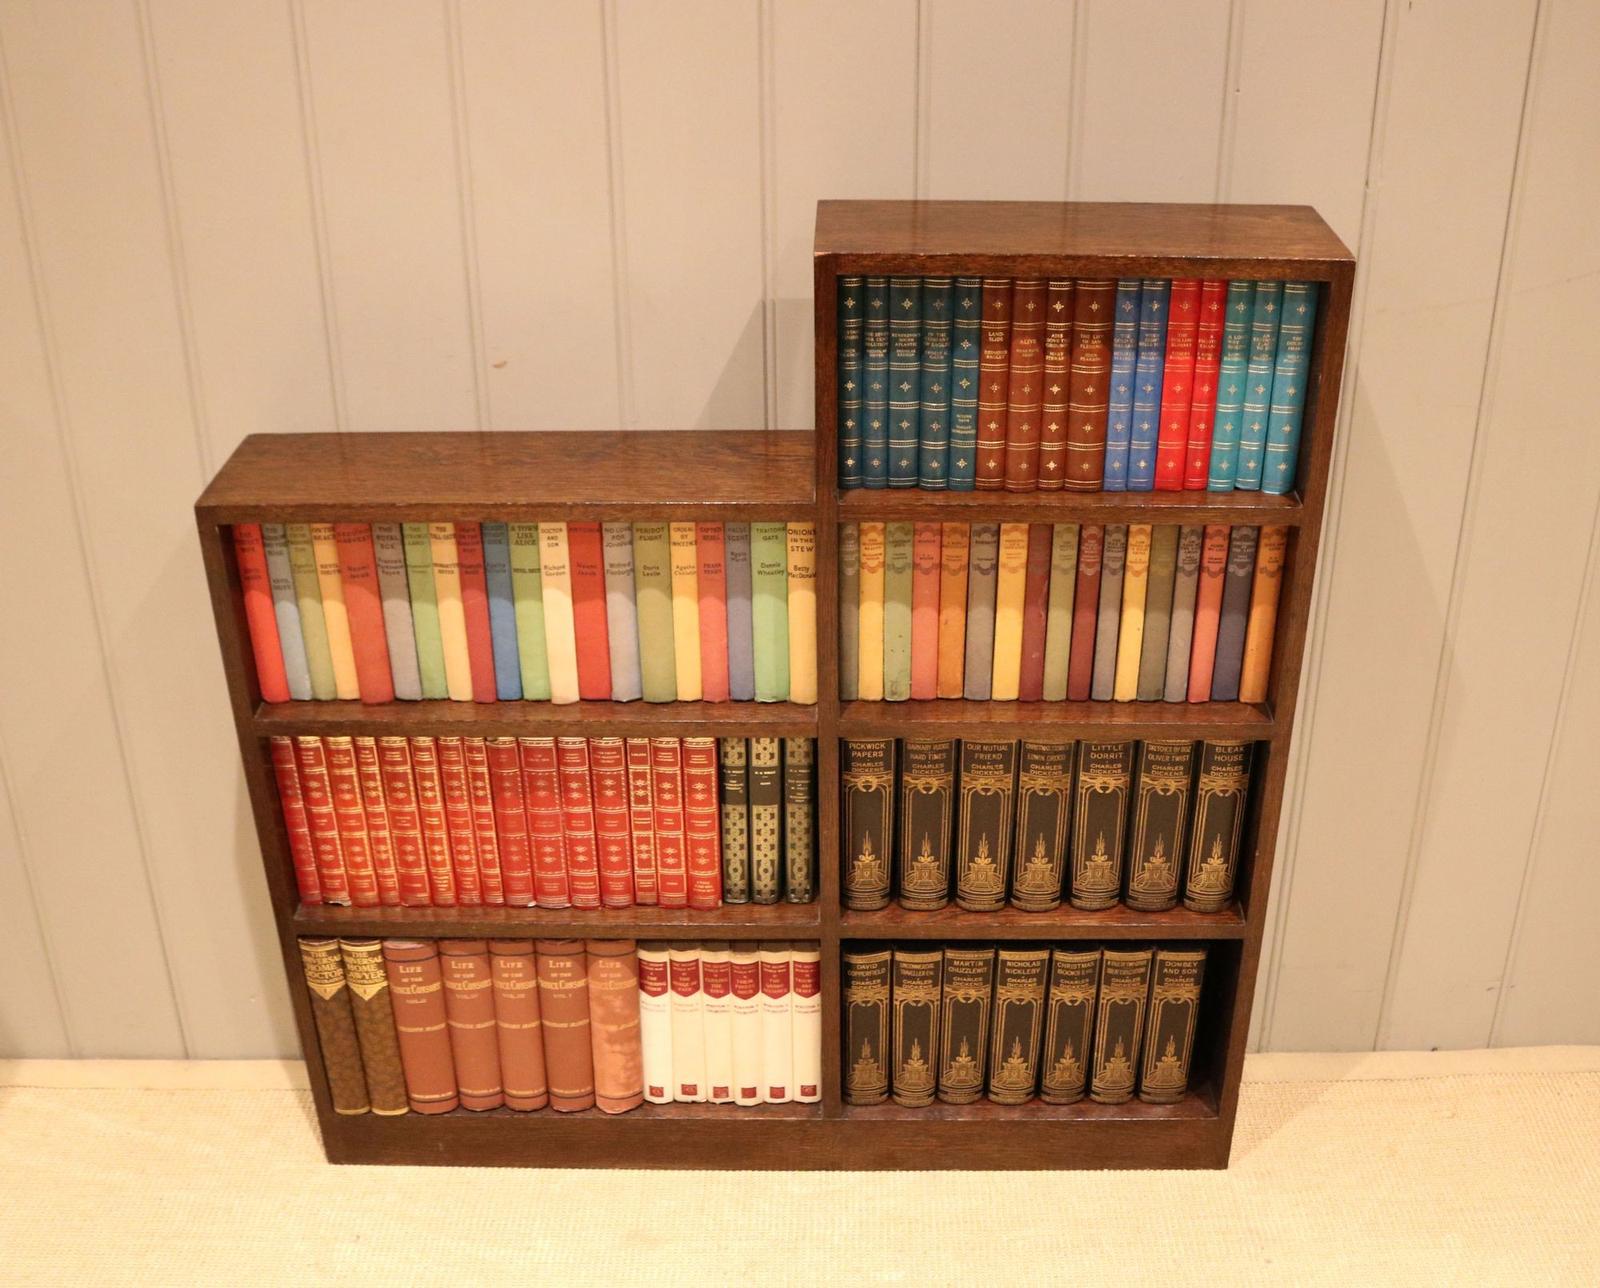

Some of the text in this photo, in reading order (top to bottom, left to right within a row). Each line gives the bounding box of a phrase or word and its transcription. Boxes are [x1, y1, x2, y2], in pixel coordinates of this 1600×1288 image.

[787, 527, 818, 535] ONIONS
[757, 568, 785, 577] Wheatley
[793, 565, 811, 573] Betty
[849, 742, 887, 750] PICKWICK
[967, 743, 1009, 752] OUR MUTUAL
[1091, 744, 1124, 752] LITTLE
[851, 750, 884, 758] PAPERS
[1090, 752, 1123, 760] DORRIT
[1147, 754, 1190, 762] OLIVER TWIST
[1213, 754, 1245, 762] HOUSE
[347, 962, 379, 972] HOME
[1005, 960, 1041, 968] NICHOLAS
[1057, 962, 1095, 970] CHRISTMAS
[948, 967, 988, 975] CHUZZLEWIT
[1004, 967, 1041, 975] NICKLEBY
[1162, 967, 1199, 975] AND SON
